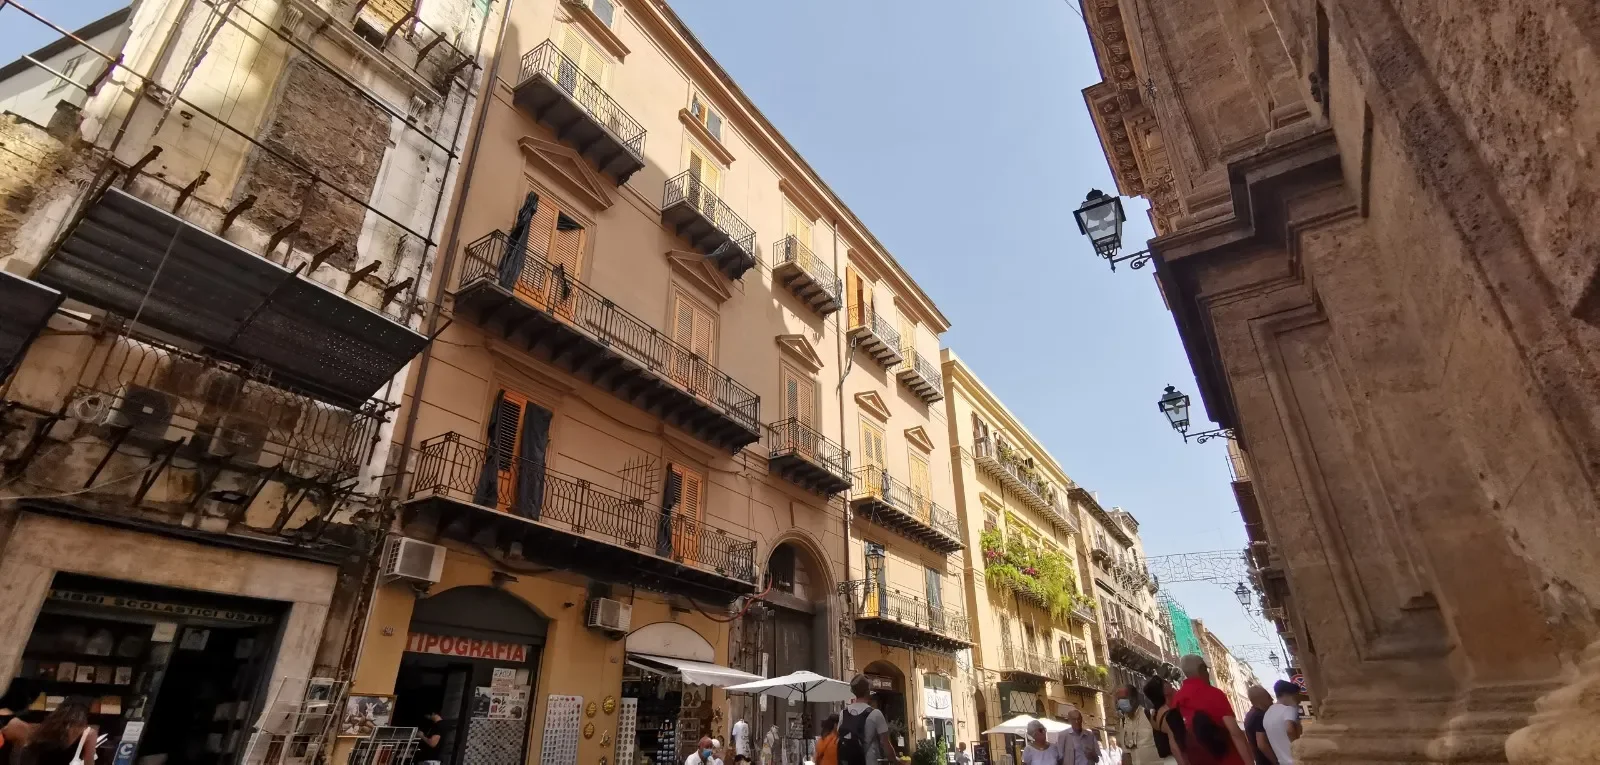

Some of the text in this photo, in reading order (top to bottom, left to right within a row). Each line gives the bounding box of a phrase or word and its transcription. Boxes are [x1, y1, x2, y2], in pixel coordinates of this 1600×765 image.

[51, 590, 105, 605] LIBRI
[113, 596, 219, 618] SCOLASTICI
[405, 632, 524, 662] TIPOGRAFIA
